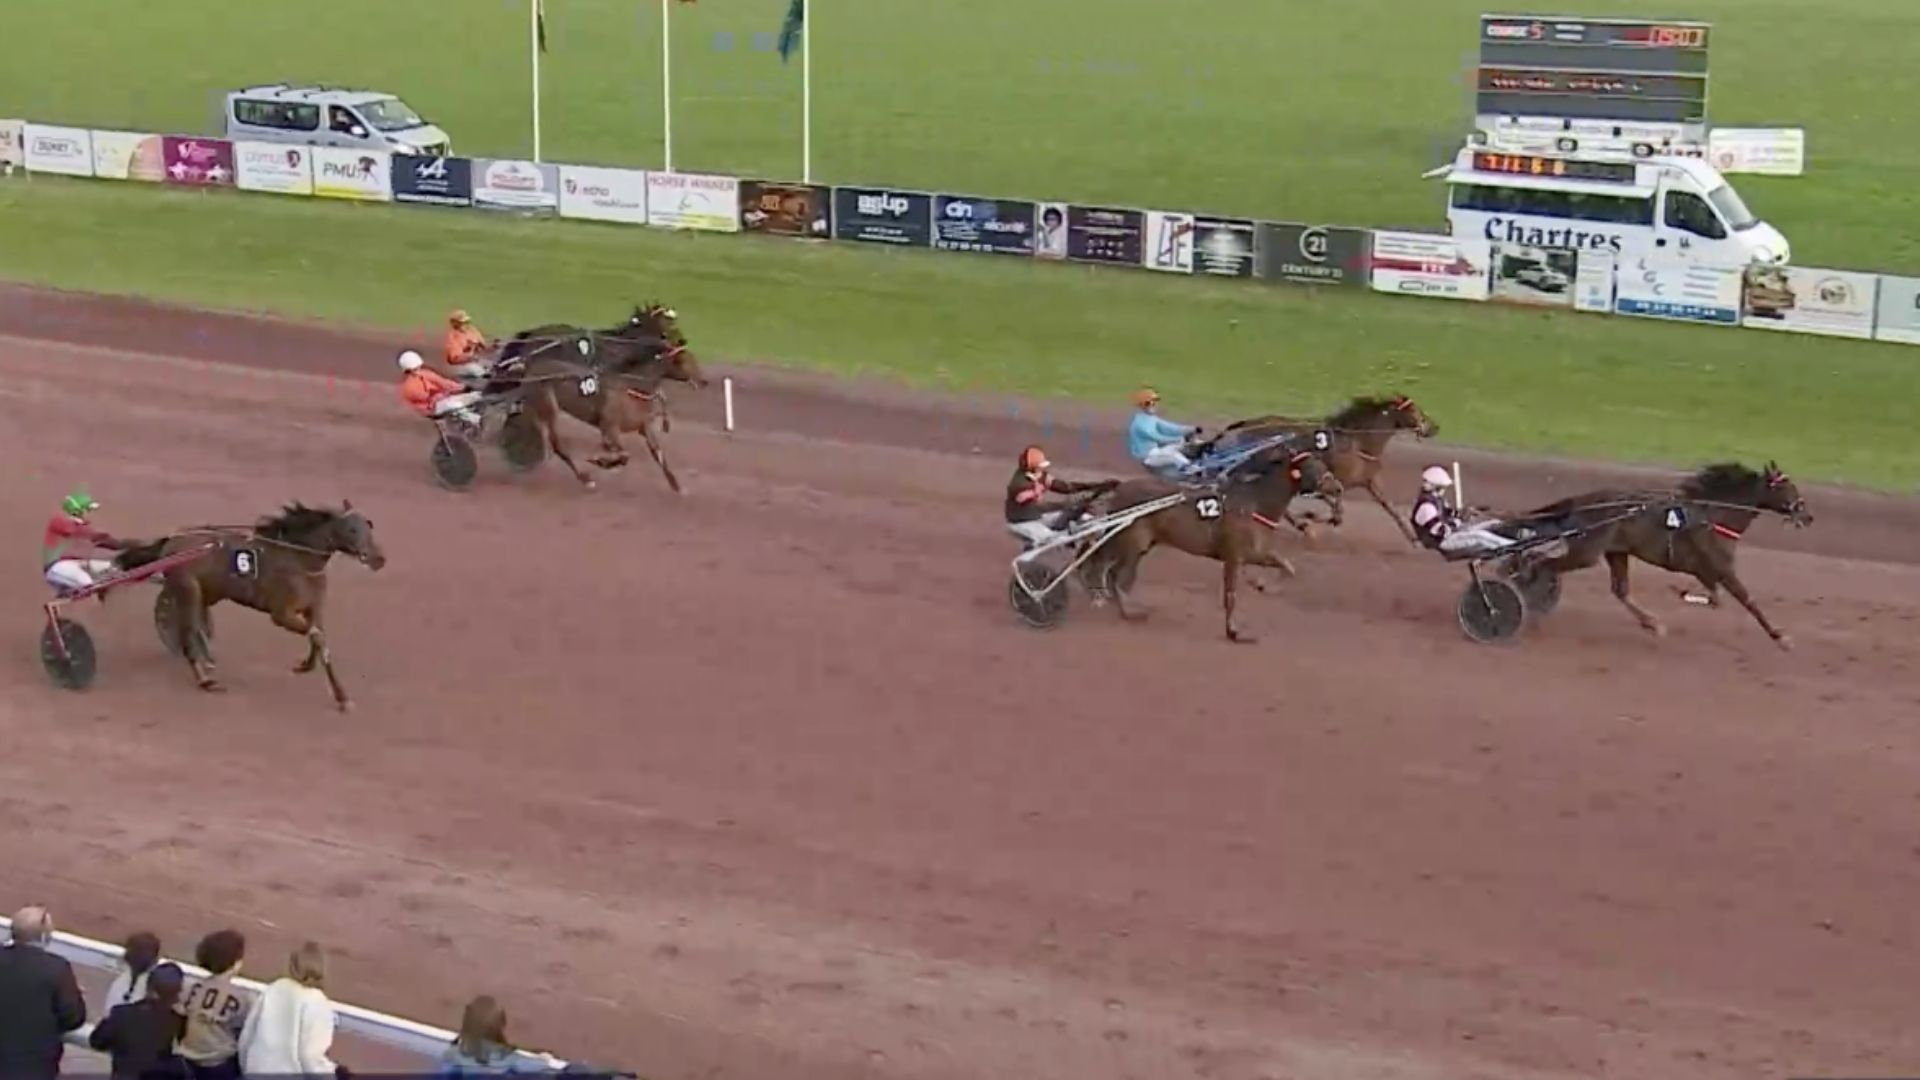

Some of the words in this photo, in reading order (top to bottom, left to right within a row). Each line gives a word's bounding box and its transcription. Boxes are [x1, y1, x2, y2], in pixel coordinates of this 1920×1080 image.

[323, 161, 356, 178] PMU
[1484, 216, 1622, 252] Chartres
[577, 339, 589, 356] 9
[580, 378, 596, 396] 10
[1315, 432, 1328, 450] 3
[1196, 499, 1220, 517] 12
[1666, 509, 1680, 528] 4
[236, 552, 251, 573] 6
